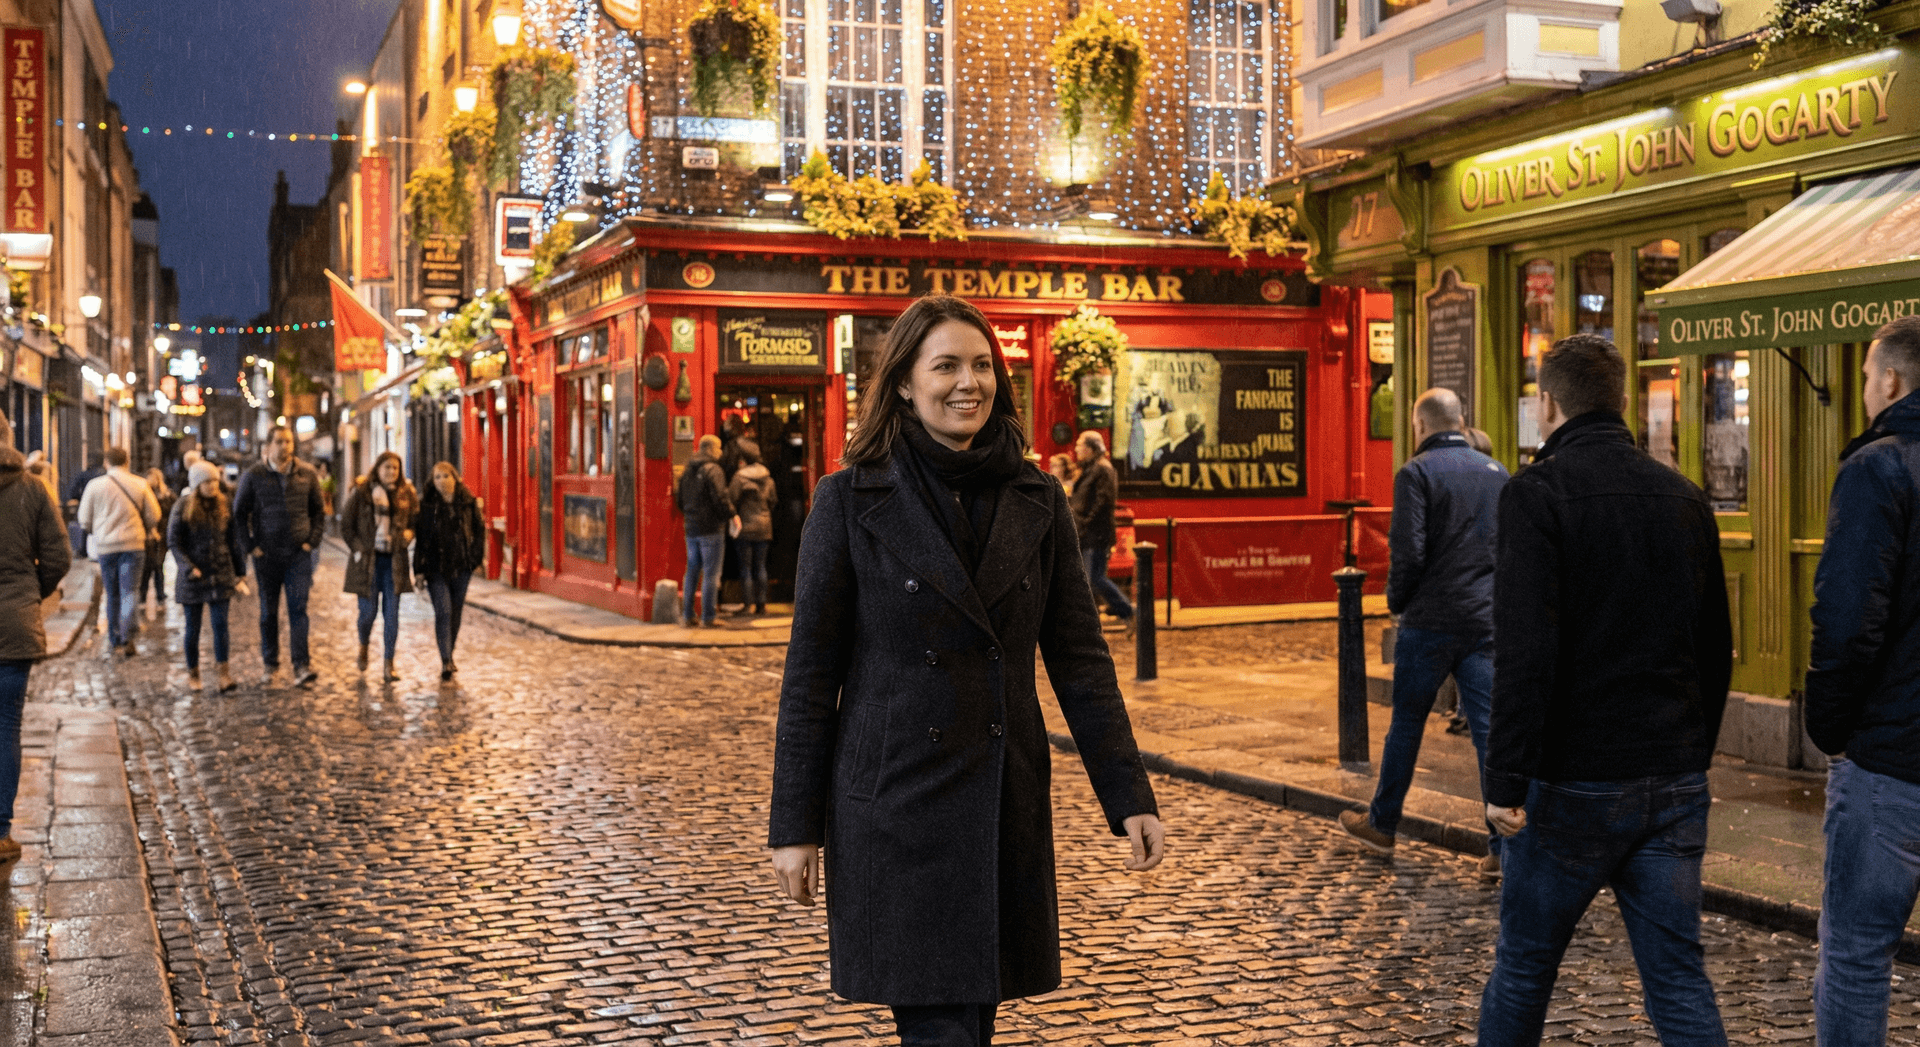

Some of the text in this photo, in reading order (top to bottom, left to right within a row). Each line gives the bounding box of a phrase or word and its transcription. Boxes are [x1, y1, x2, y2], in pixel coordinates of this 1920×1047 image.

[11, 39, 37, 228] TEMPLE BAR
[1459, 71, 1898, 211] OLIVER ST. JOHN GOGARTY
[821, 265, 1185, 301] THE TEMPLE BAR
[1670, 317, 1736, 343] OLIVER
[1740, 310, 1766, 337] ST.
[1772, 307, 1824, 341] JOHN
[1267, 368, 1293, 388] THE
[1279, 412, 1294, 430] IS
